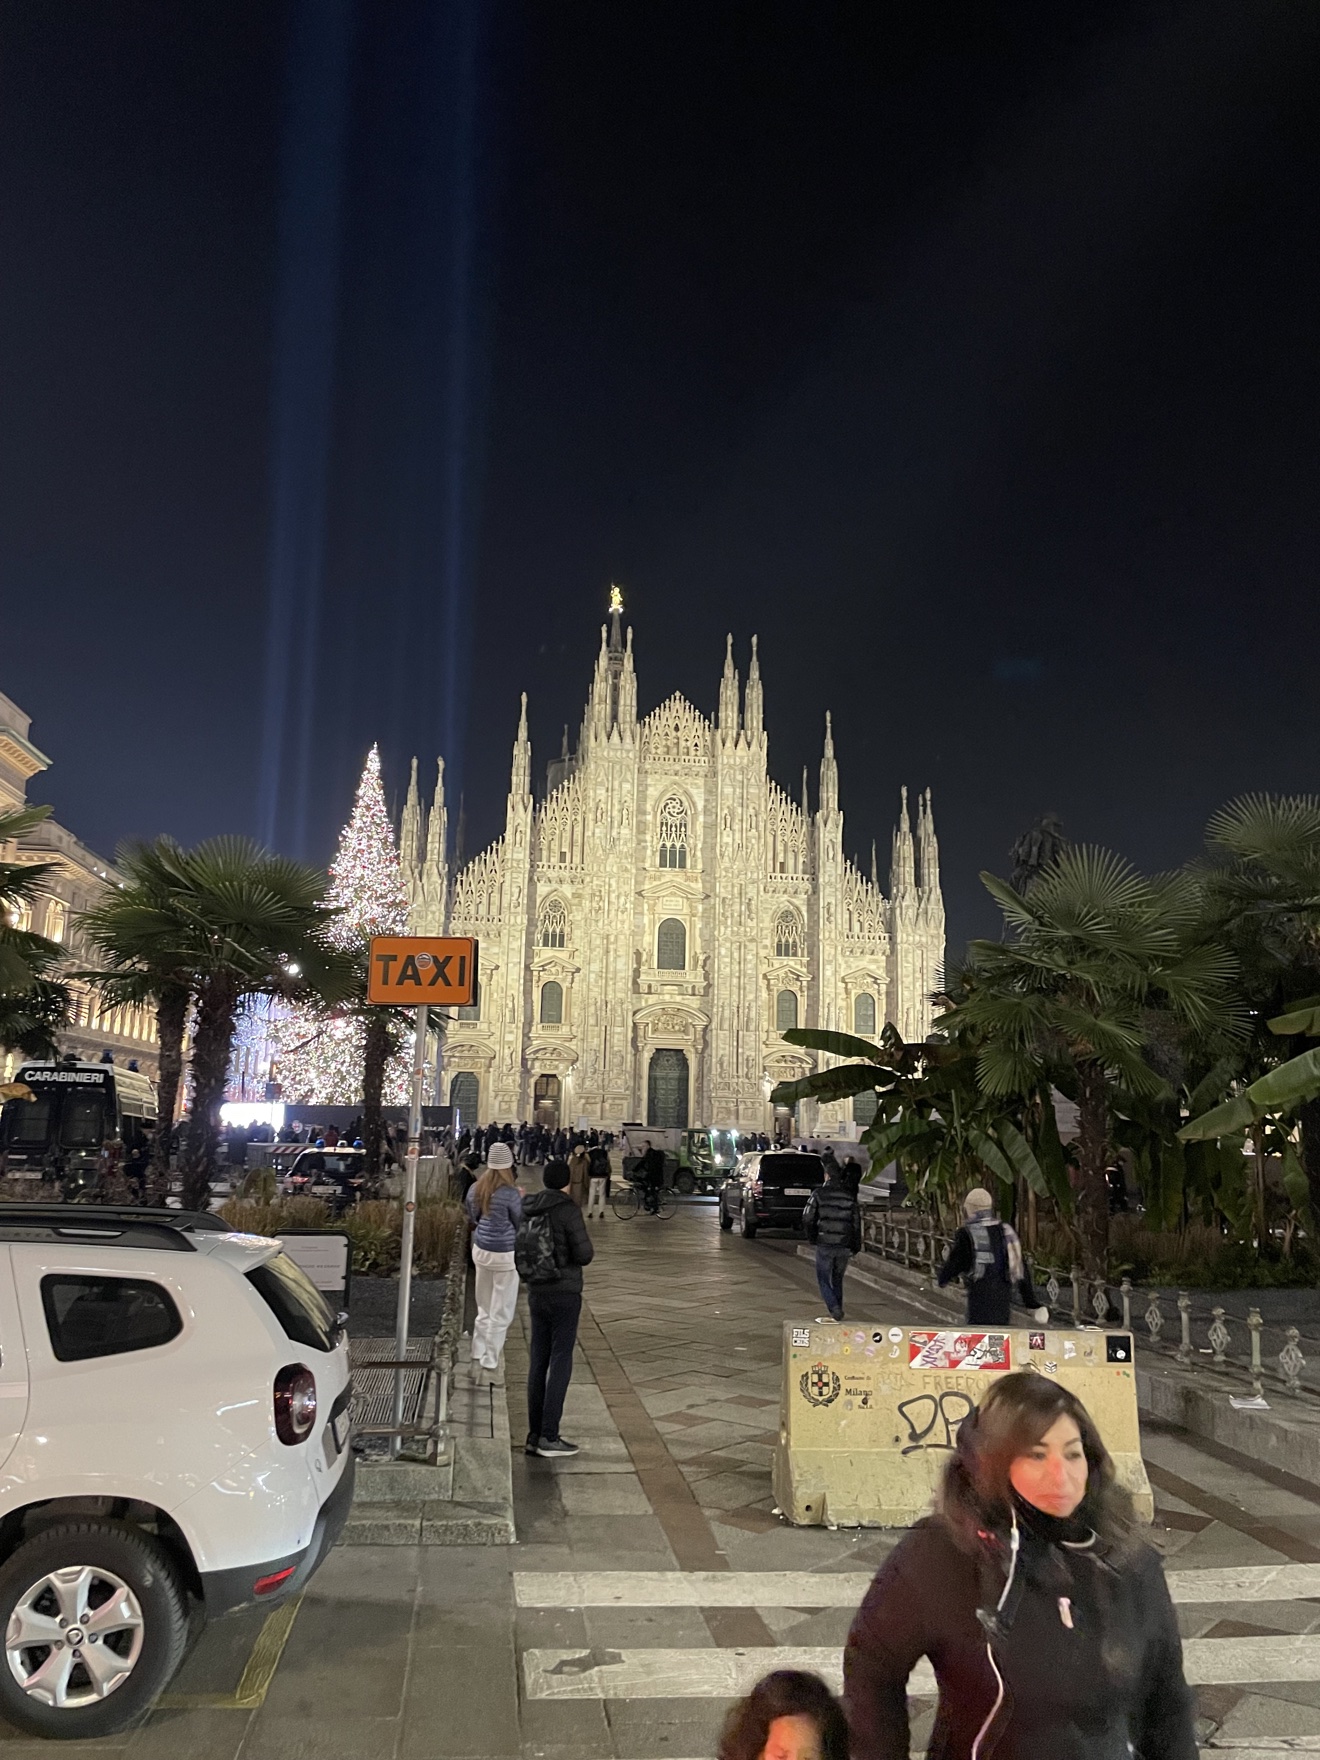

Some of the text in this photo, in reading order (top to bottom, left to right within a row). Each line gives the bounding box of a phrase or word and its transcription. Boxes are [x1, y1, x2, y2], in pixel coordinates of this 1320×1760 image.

[375, 954, 466, 986] TAXI
[24, 1070, 105, 1083] CARABINIERI
[845, 1388, 873, 1396] Milano
